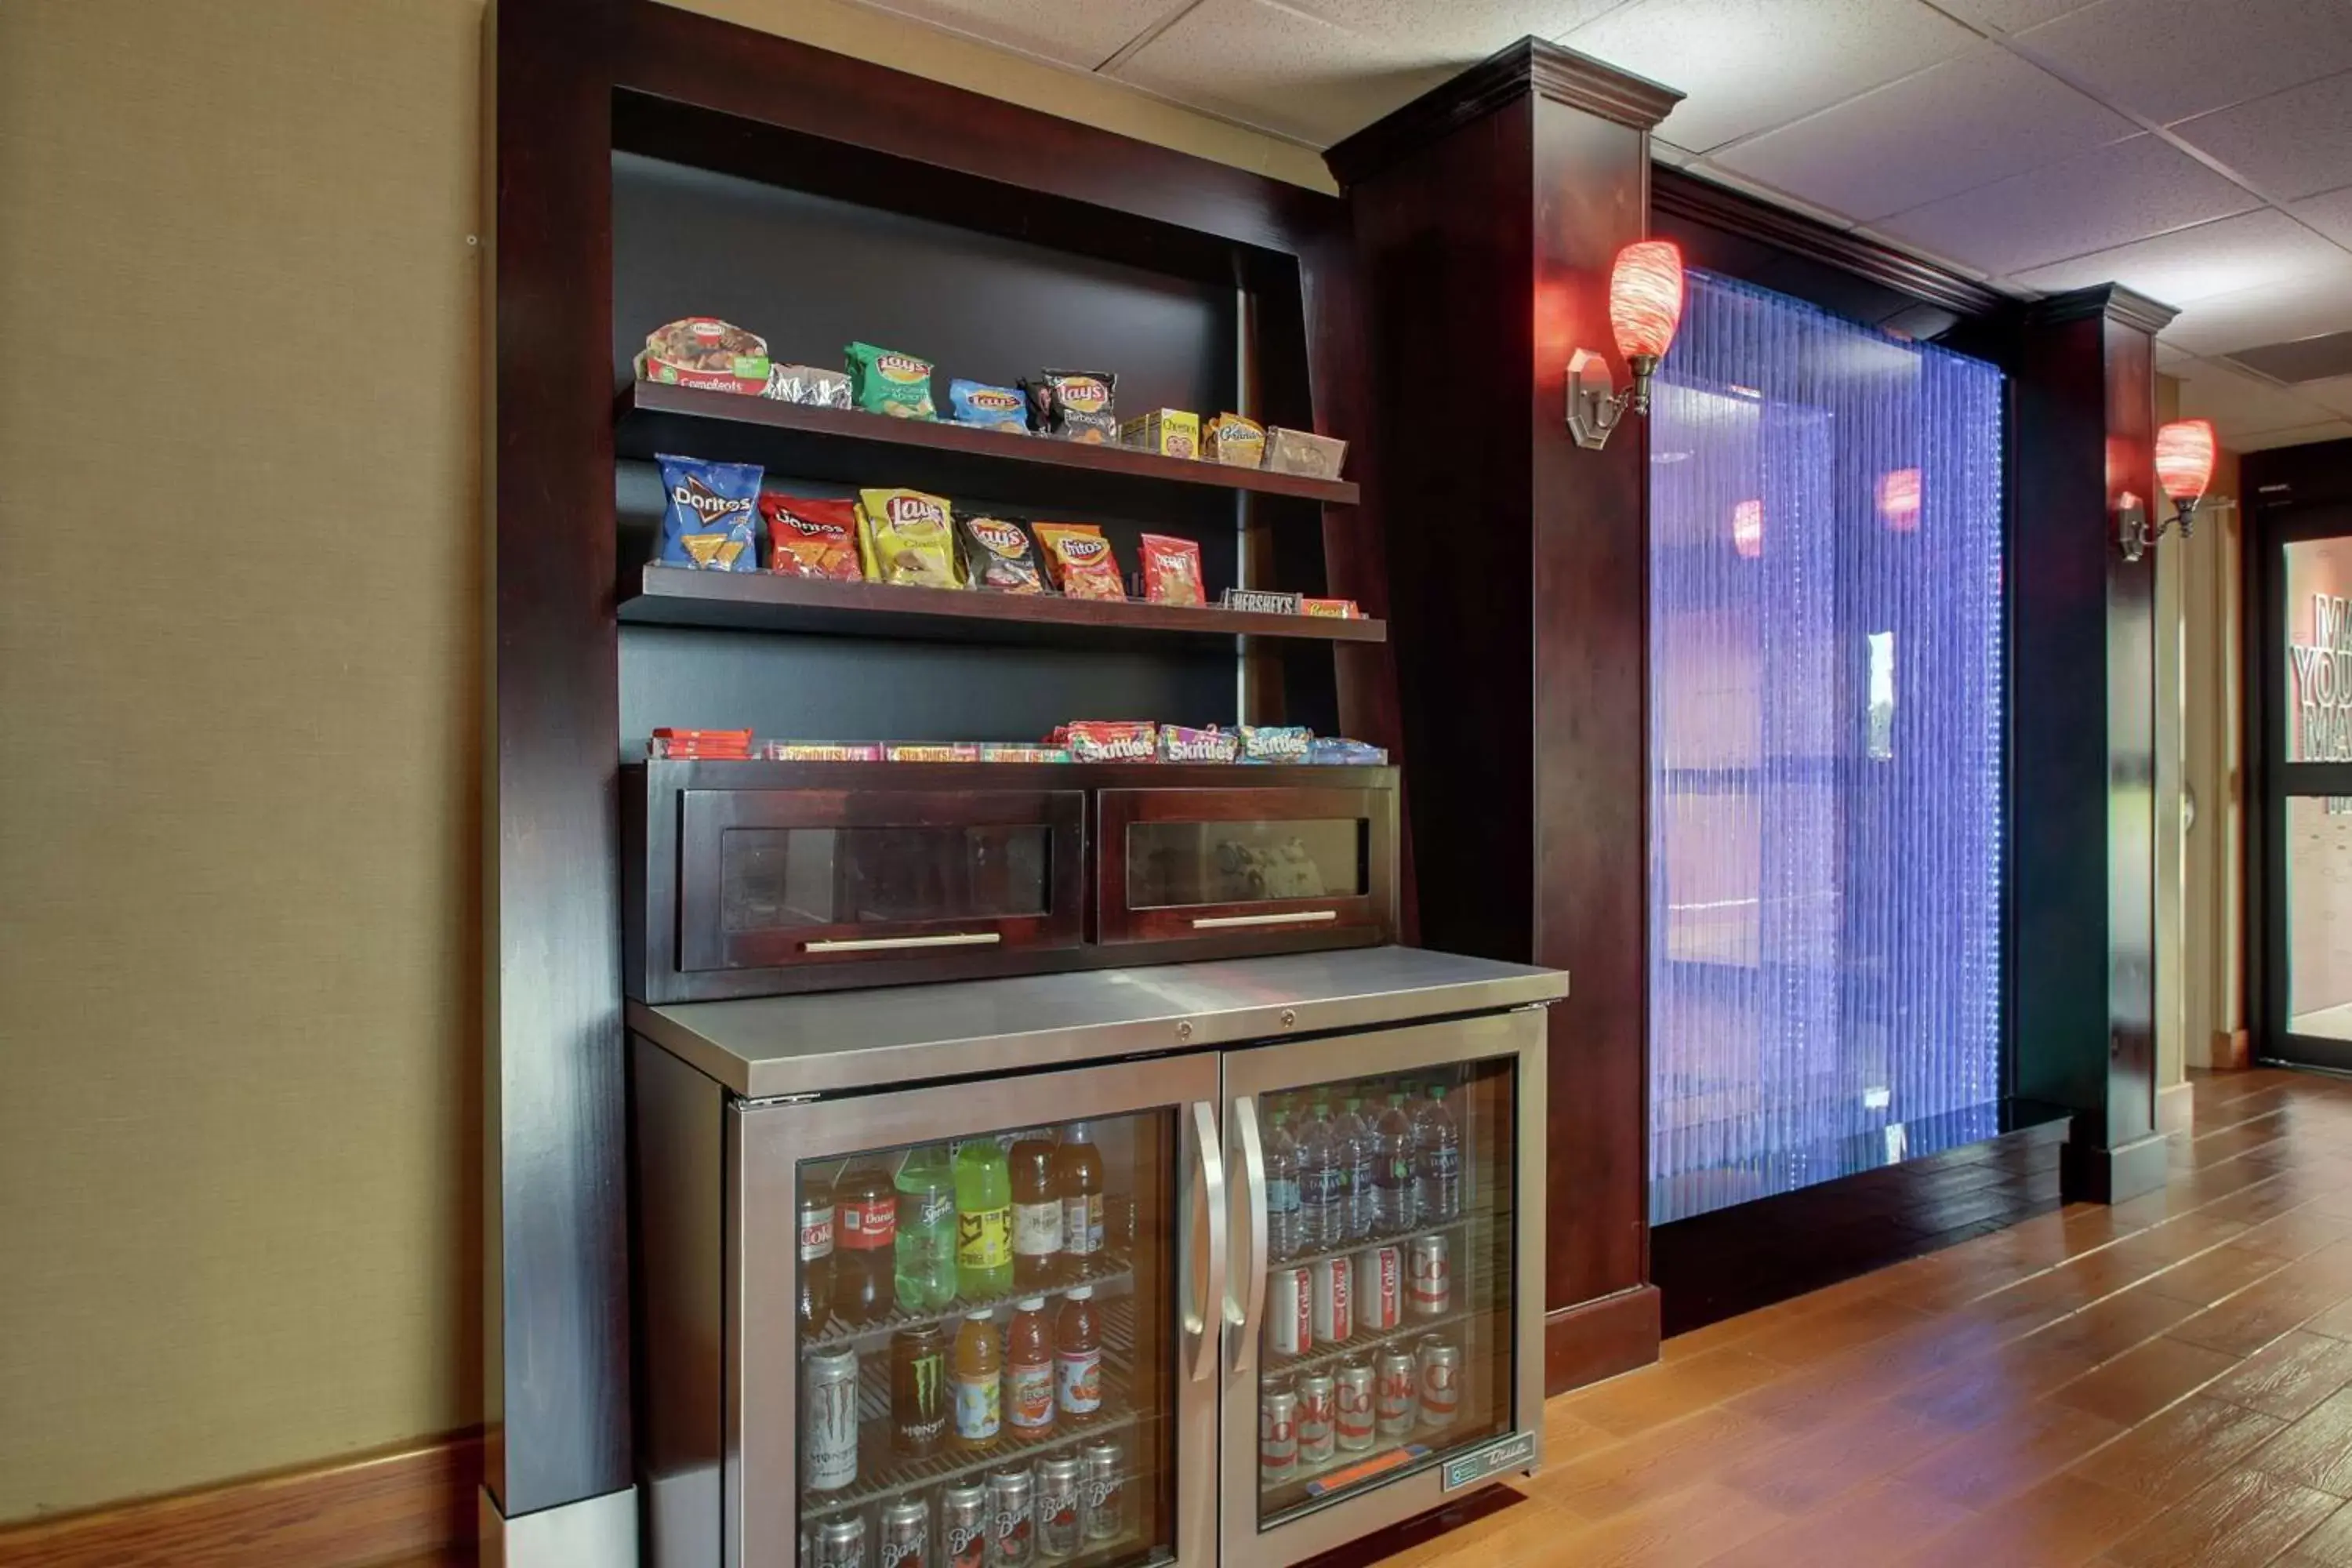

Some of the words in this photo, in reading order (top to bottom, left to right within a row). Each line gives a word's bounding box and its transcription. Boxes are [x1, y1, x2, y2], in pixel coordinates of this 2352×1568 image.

[1059, 385, 1102, 401] Lay's
[675, 486, 751, 512] Doritos
[776, 512, 845, 533] Doritos
[1233, 593, 1294, 615] HERSHEY'S
[1083, 739, 1154, 761] Skittles
[1170, 741, 1235, 760] Skittles
[1247, 736, 1308, 757] Skittles
